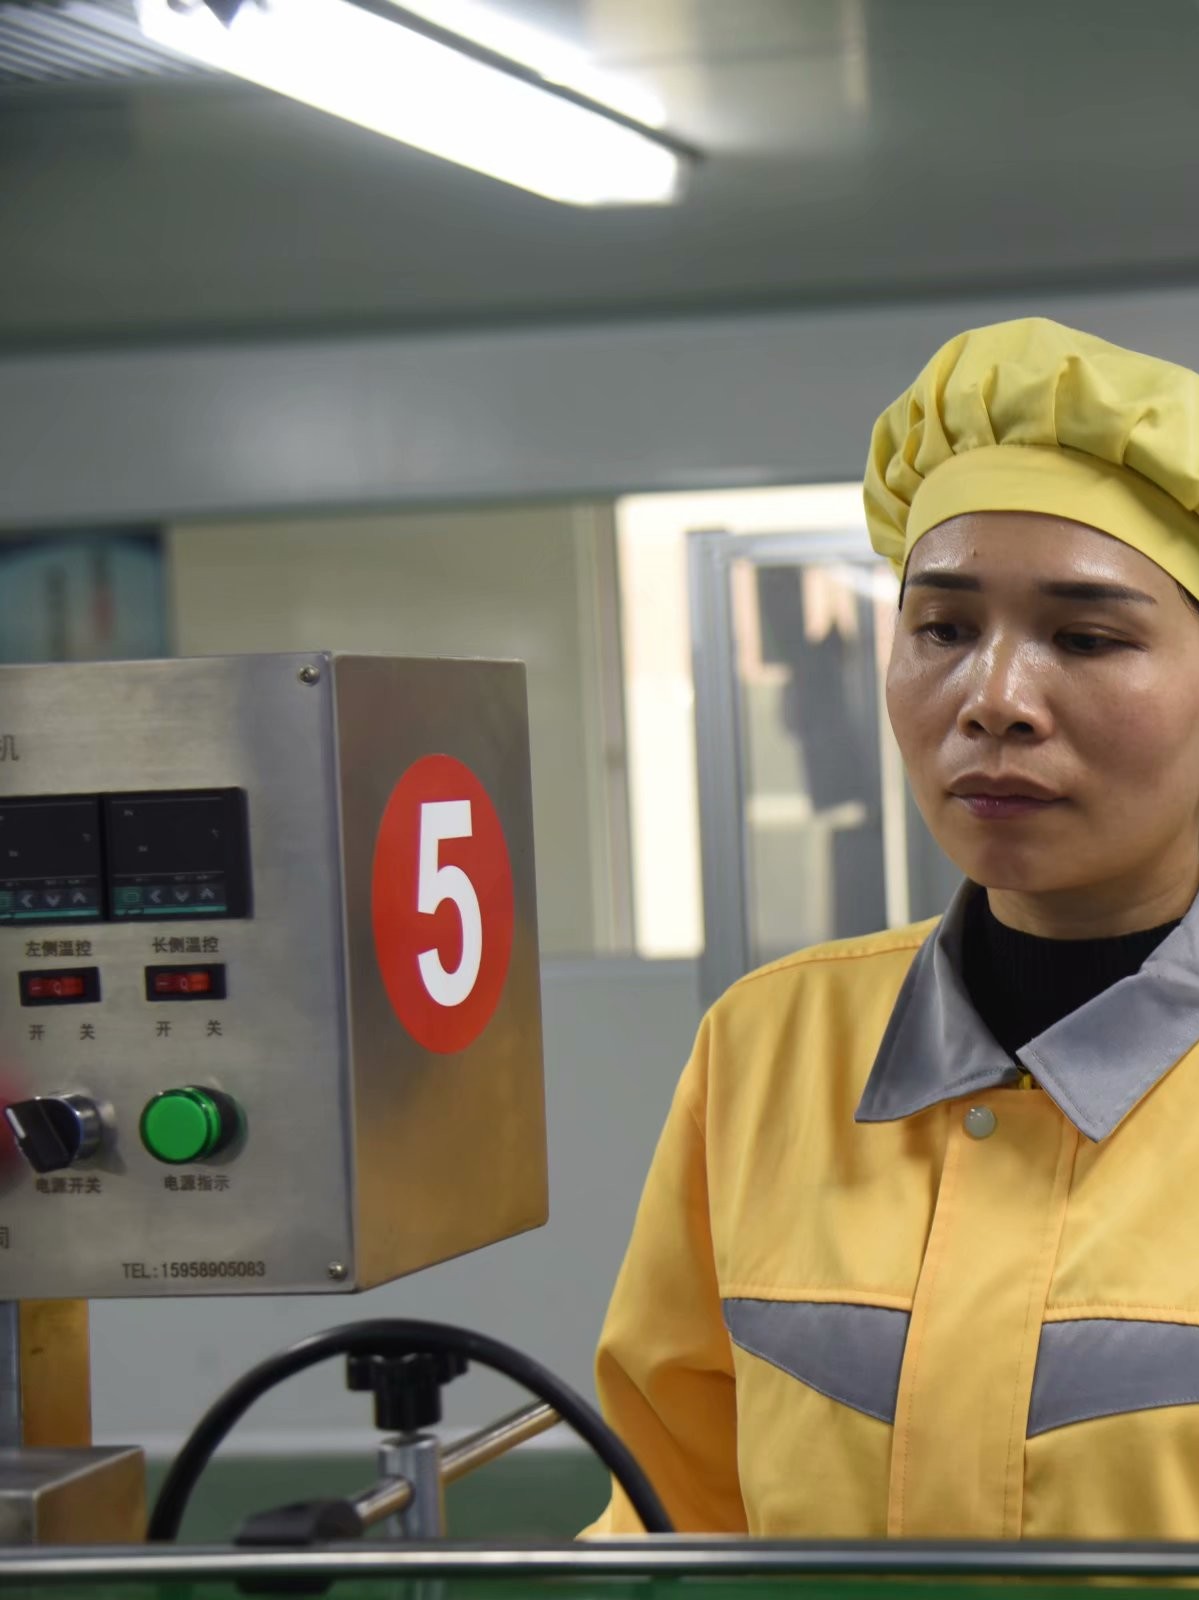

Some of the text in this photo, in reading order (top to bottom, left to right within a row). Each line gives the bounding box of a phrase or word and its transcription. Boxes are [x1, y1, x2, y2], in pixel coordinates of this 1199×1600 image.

[417, 799, 482, 1007] 5
[25, 940, 93, 957] 左侧温控
[29, 1023, 95, 1040] 开 关
[156, 1020, 223, 1037] 开 关
[35, 1177, 102, 1194] 电源开关
[164, 1174, 231, 1192] 电源指示
[122, 1261, 266, 1280] TEL:15958905083
